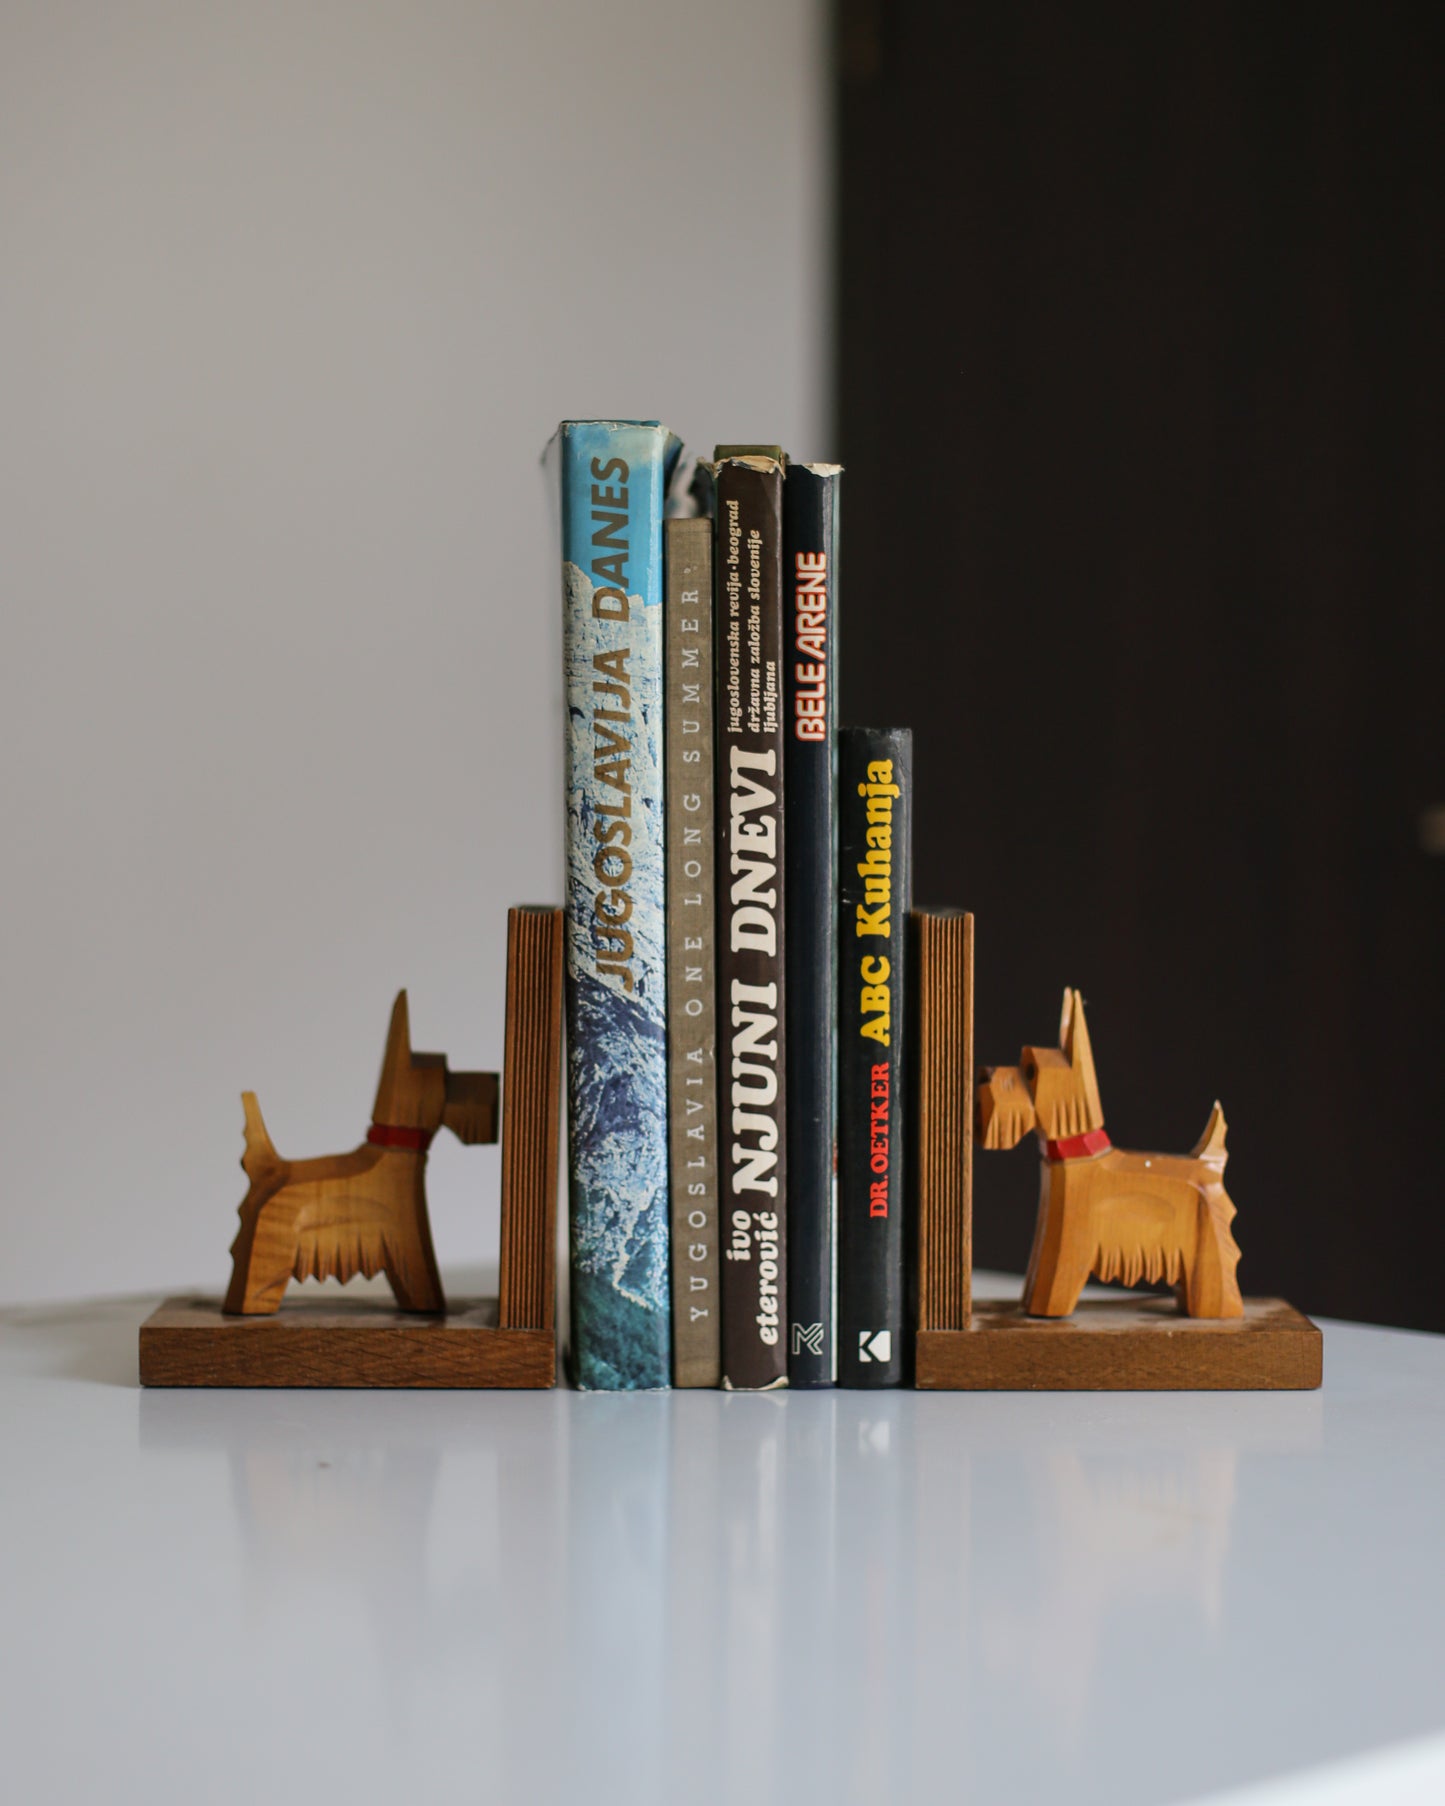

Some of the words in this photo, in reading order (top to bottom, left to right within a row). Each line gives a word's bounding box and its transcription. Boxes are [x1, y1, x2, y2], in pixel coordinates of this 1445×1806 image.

[590, 456, 631, 623] DANES
[747, 530, 763, 600] slovenije
[747, 605, 761, 664] založba
[795, 552, 827, 661] ARENE
[681, 589, 701, 764] SUMMER
[727, 621, 743, 733] jugoslovenska
[747, 668, 761, 733] državna
[763, 661, 778, 733] ljubljana
[795, 662, 826, 741] BELE
[592, 648, 634, 993] JUGOSLAVIJA
[683, 794, 702, 915] LONG
[729, 745, 777, 957] DNEVI
[856, 759, 900, 938] Kuhanja
[685, 937, 704, 1017] ONE
[860, 955, 891, 1047] ABC
[731, 978, 779, 1198] NJUNI
[686, 1047, 709, 1322] YUGOSLAVIA
[726, 1209, 752, 1261] ivo
[752, 1211, 779, 1345] eterović
